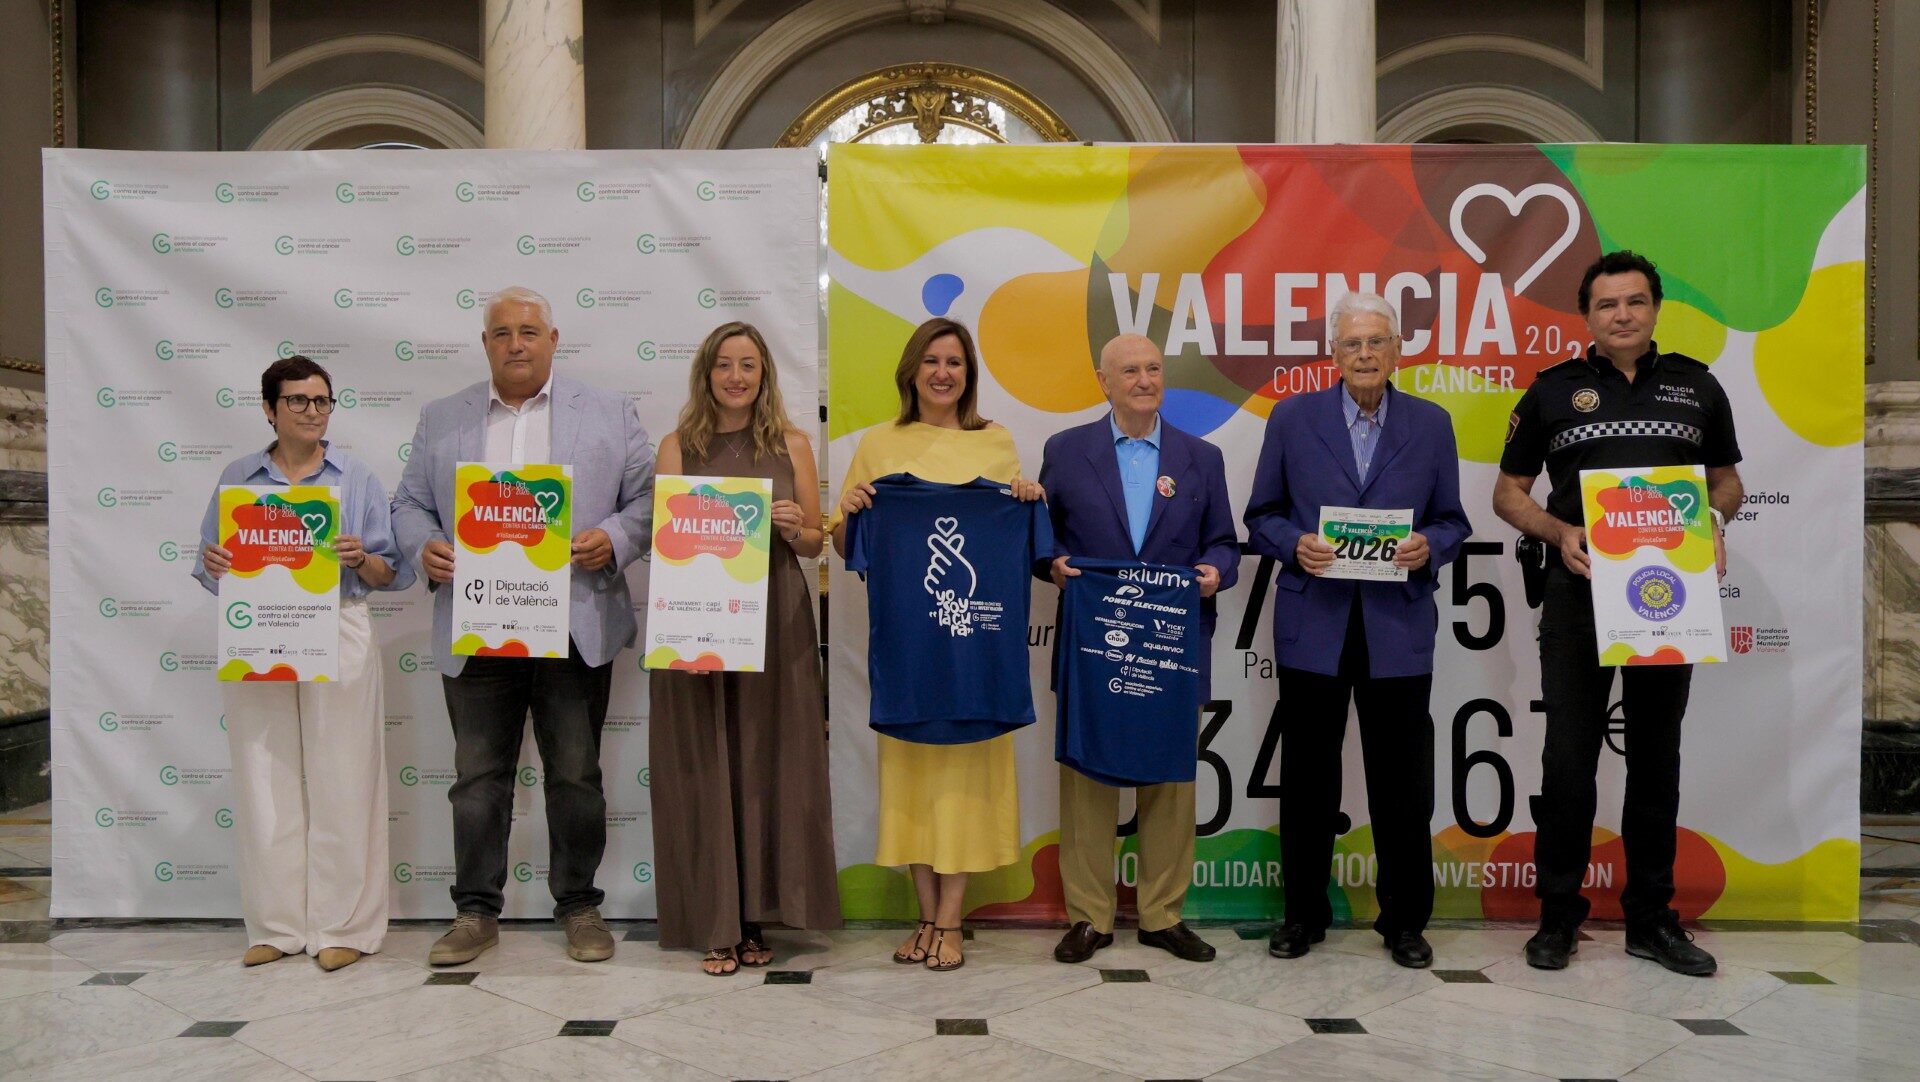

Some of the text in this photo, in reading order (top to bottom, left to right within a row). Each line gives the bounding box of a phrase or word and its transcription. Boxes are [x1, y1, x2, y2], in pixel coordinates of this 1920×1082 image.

[1273, 366, 1337, 394] CONT
[1416, 360, 1515, 394] CÁNCER
[1660, 384, 1695, 394] POLICIA
[498, 481, 512, 499] 18
[1627, 486, 1643, 503] 18
[697, 494, 711, 511] 18
[262, 503, 277, 521] 18
[474, 506, 548, 523] VALENCIA
[1605, 510, 1685, 528] VALENCIA
[672, 518, 746, 536] VALENCIA
[238, 529, 314, 546] VALENCIA
[1334, 535, 1398, 562] 2026
[1656, 571, 1677, 585] LOCAL
[496, 580, 549, 594] Diputació
[496, 595, 558, 607] de València
[936, 589, 955, 606] yo
[943, 598, 969, 613] soy
[1102, 595, 1188, 615] POWER ELECTRONICS
[283, 611, 291, 619] el
[298, 604, 332, 614] española
[1638, 602, 1681, 619] VALÈNCIA
[268, 620, 301, 628] Valencia
[1756, 640, 1790, 648] Municipal
[1193, 860, 1284, 887] OLIDAR
